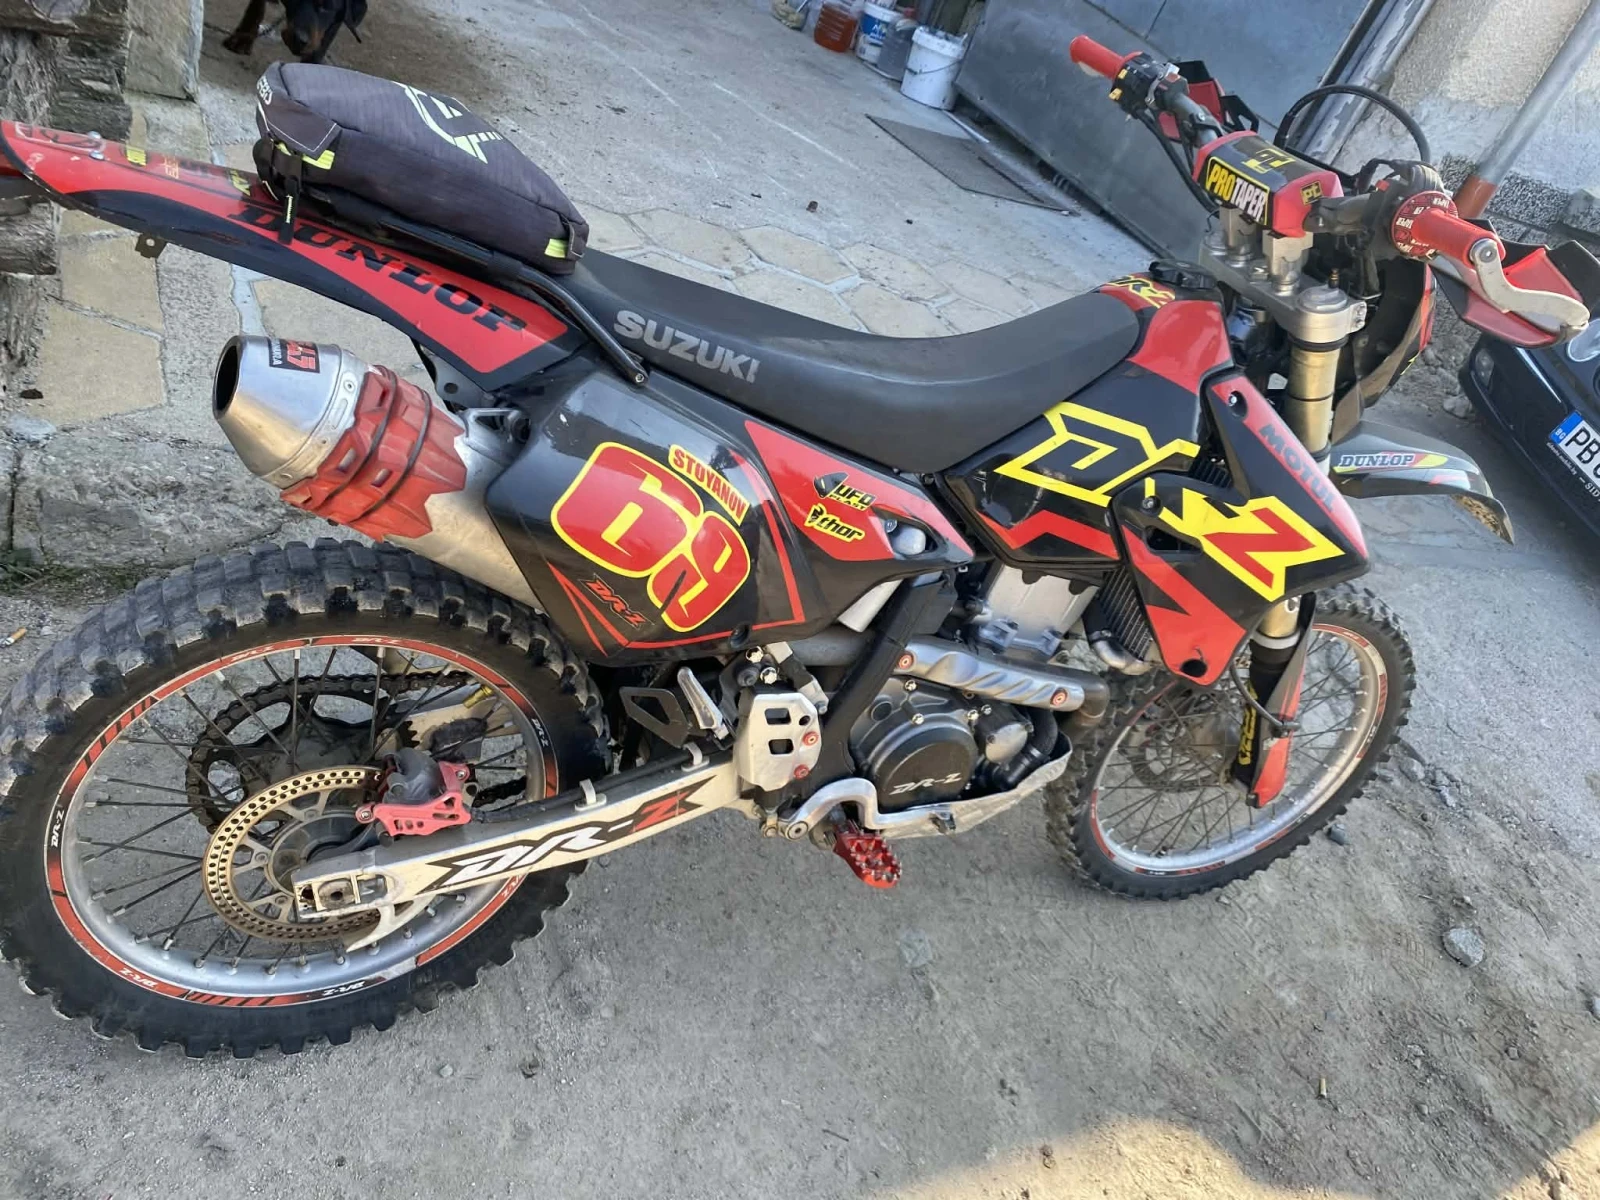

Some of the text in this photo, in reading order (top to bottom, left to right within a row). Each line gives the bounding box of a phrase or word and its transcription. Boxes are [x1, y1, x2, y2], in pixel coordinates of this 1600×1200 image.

[228, 203, 528, 332] DUNLOP
[613, 309, 761, 384] SUZUKI
[1554, 428, 1567, 440] BG
[1259, 424, 1335, 512] MOTUL
[1339, 454, 1416, 468] DUNLOP
[673, 448, 748, 522] STOYANOV
[833, 484, 877, 506] UFO
[551, 441, 751, 633] 69
[816, 515, 863, 539] thor
[584, 577, 647, 627] DR-Z
[888, 772, 962, 796] DR-Z
[51, 810, 65, 848] DR-Z
[441, 790, 692, 887] DR-Z
[119, 967, 158, 988] DR-Z
[322, 981, 365, 997] DR-Z
